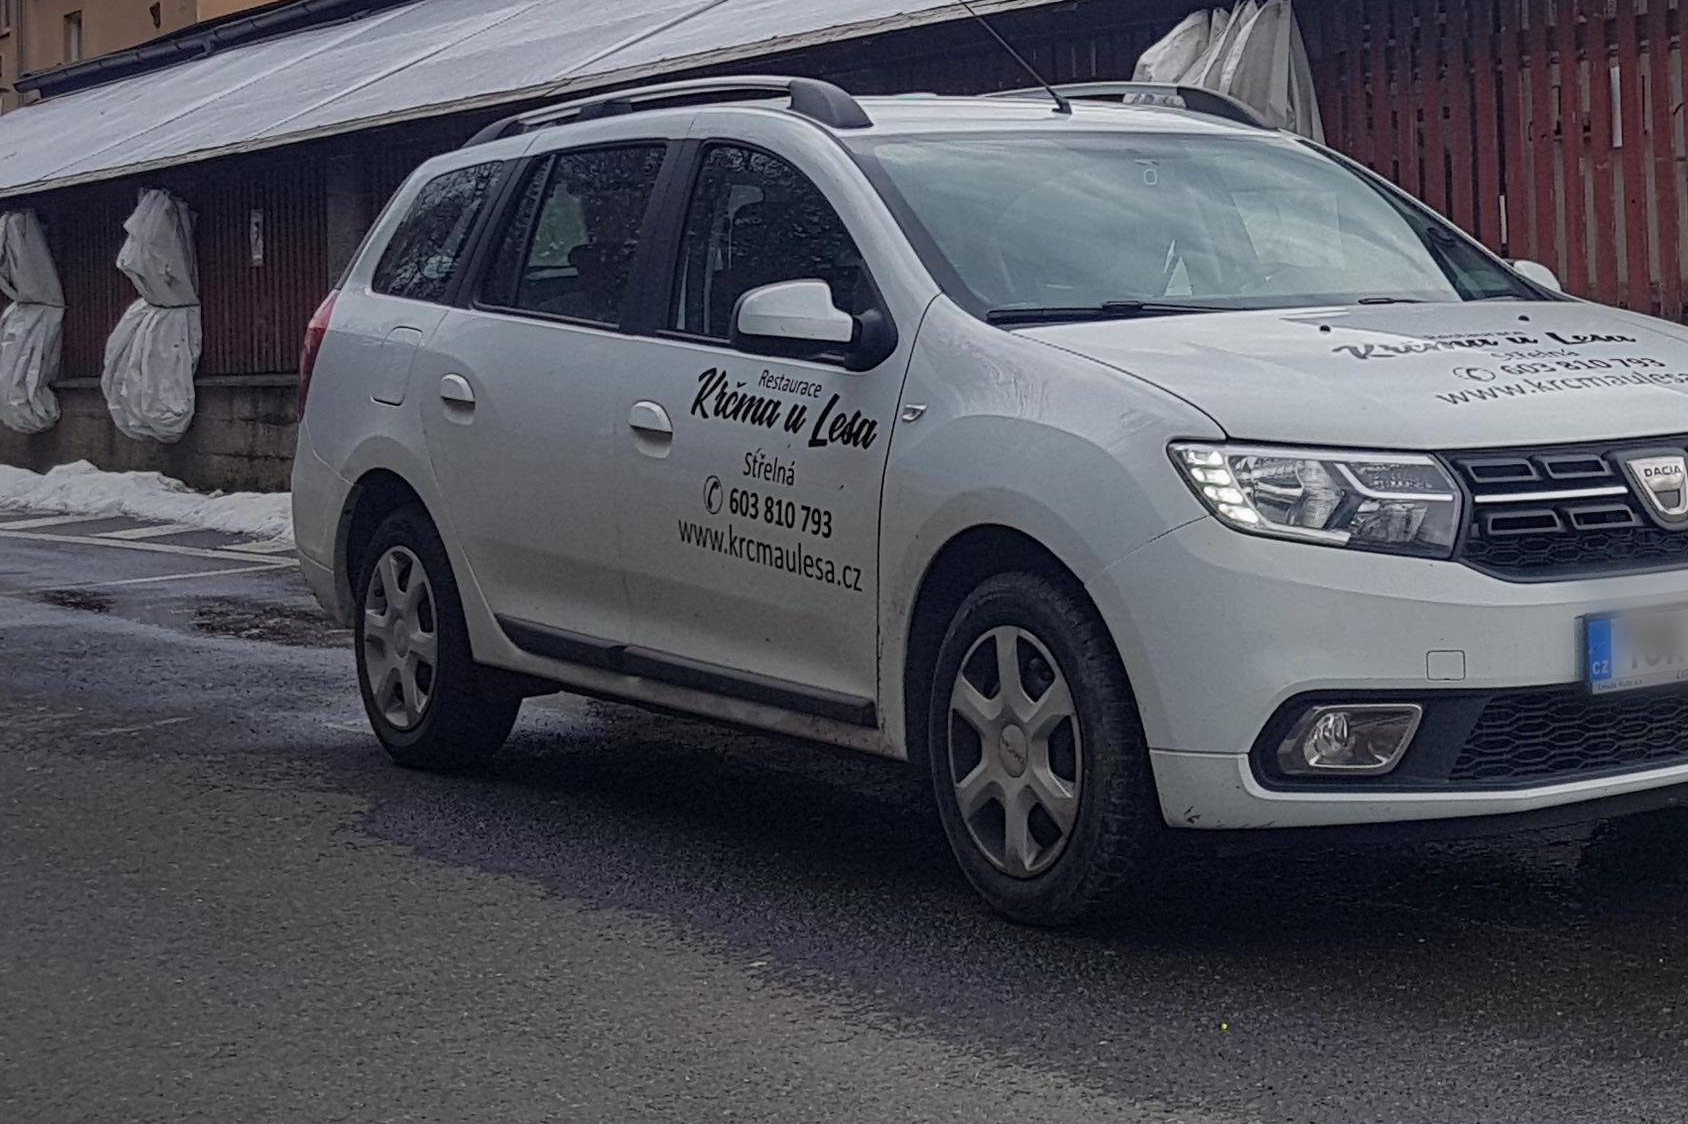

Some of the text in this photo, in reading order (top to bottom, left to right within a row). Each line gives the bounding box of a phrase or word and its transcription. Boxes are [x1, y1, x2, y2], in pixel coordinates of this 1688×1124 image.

[1500, 357, 1666, 376] 603 810 793
[758, 369, 823, 399] Restaurace
[690, 367, 878, 450] Krčma u Lesa
[743, 448, 795, 486] Střelná
[1643, 464, 1683, 478] DACIA
[729, 487, 832, 539] 603 810 793
[678, 519, 863, 592] www.krcmaulesa.cz
[1592, 659, 1609, 676] CZ
